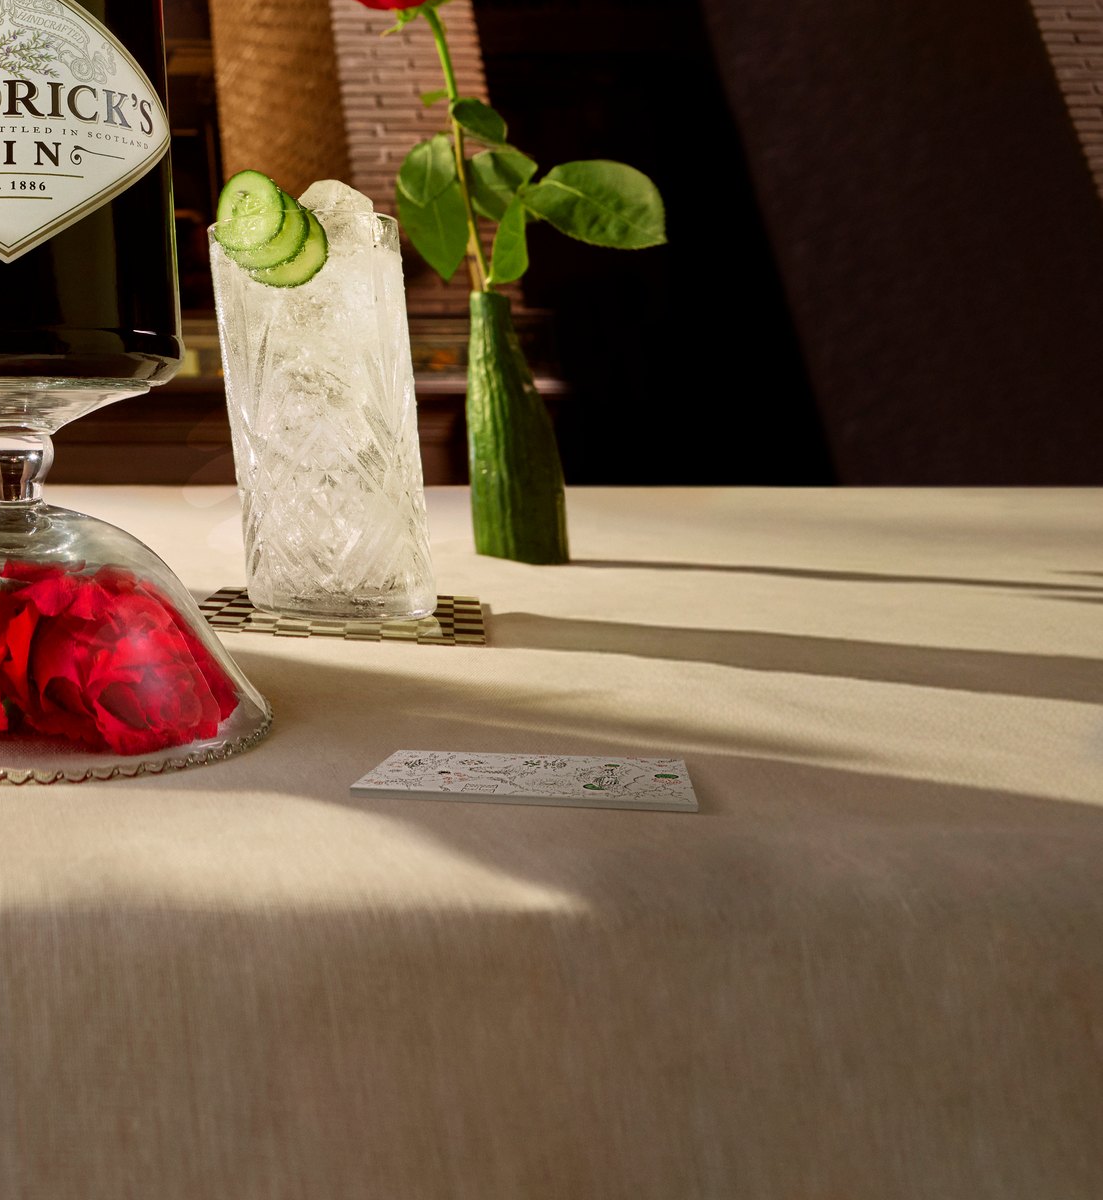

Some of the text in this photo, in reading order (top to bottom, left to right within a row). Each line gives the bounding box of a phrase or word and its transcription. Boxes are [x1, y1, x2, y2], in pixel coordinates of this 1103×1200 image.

[17, 11, 85, 45] HANDCRAFTED
[62, 128, 78, 136] IN
[87, 131, 149, 150] SCOTLAND
[11, 181, 46, 191] 1886
